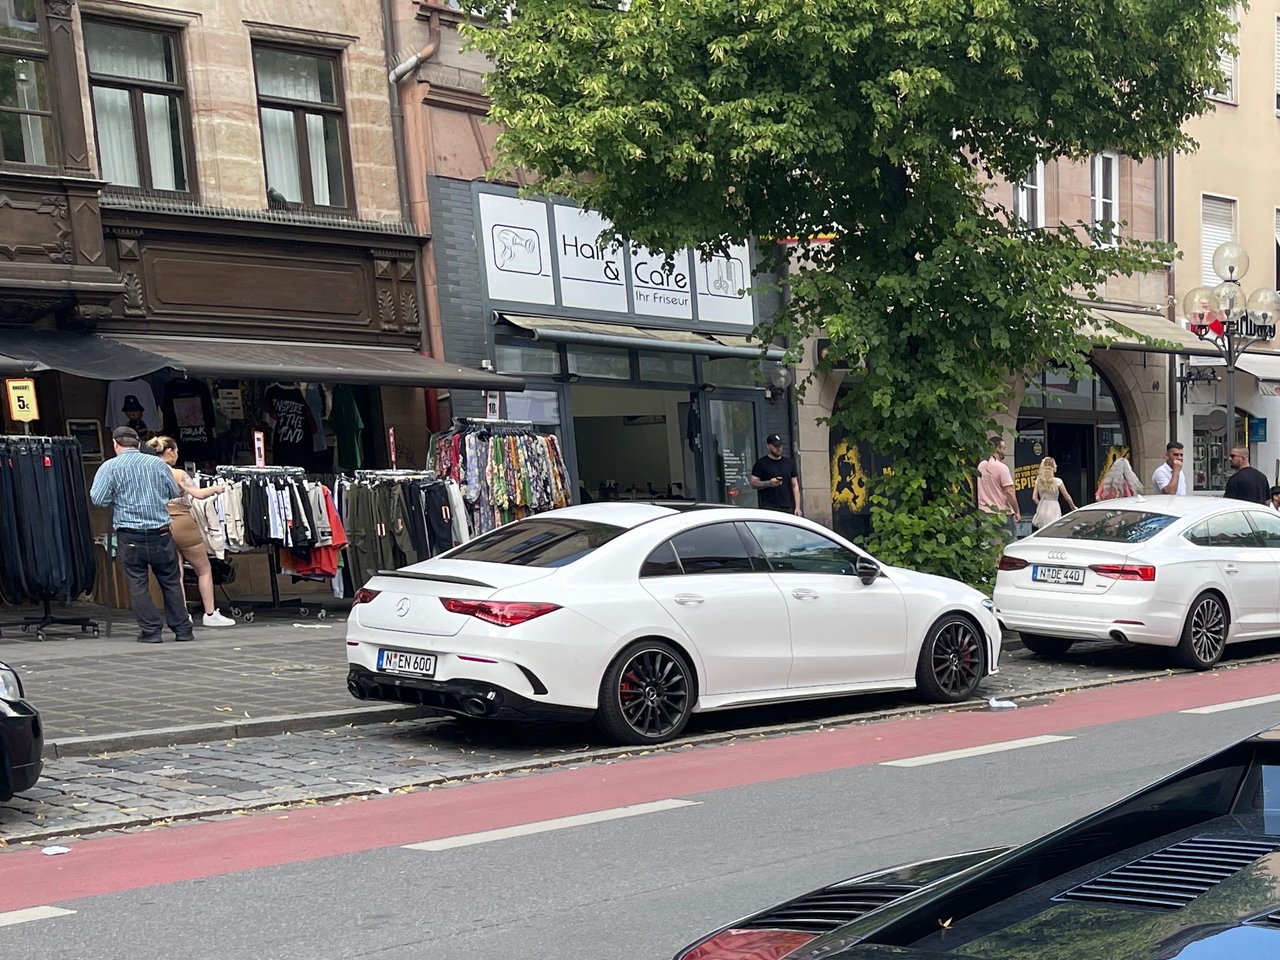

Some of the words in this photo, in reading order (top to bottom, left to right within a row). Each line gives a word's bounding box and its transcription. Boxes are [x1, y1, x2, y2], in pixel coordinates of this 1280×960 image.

[562, 234, 608, 260] Hair
[604, 260, 620, 281] &
[634, 262, 687, 288] Care
[635, 290, 650, 302] Ihr
[653, 292, 689, 306] Friseur
[1039, 568, 1046, 579] N
[1050, 569, 1062, 580] DE
[1063, 570, 1080, 581] 440
[386, 653, 392, 667] N
[398, 655, 411, 669] EN
[413, 657, 432, 672] 600
